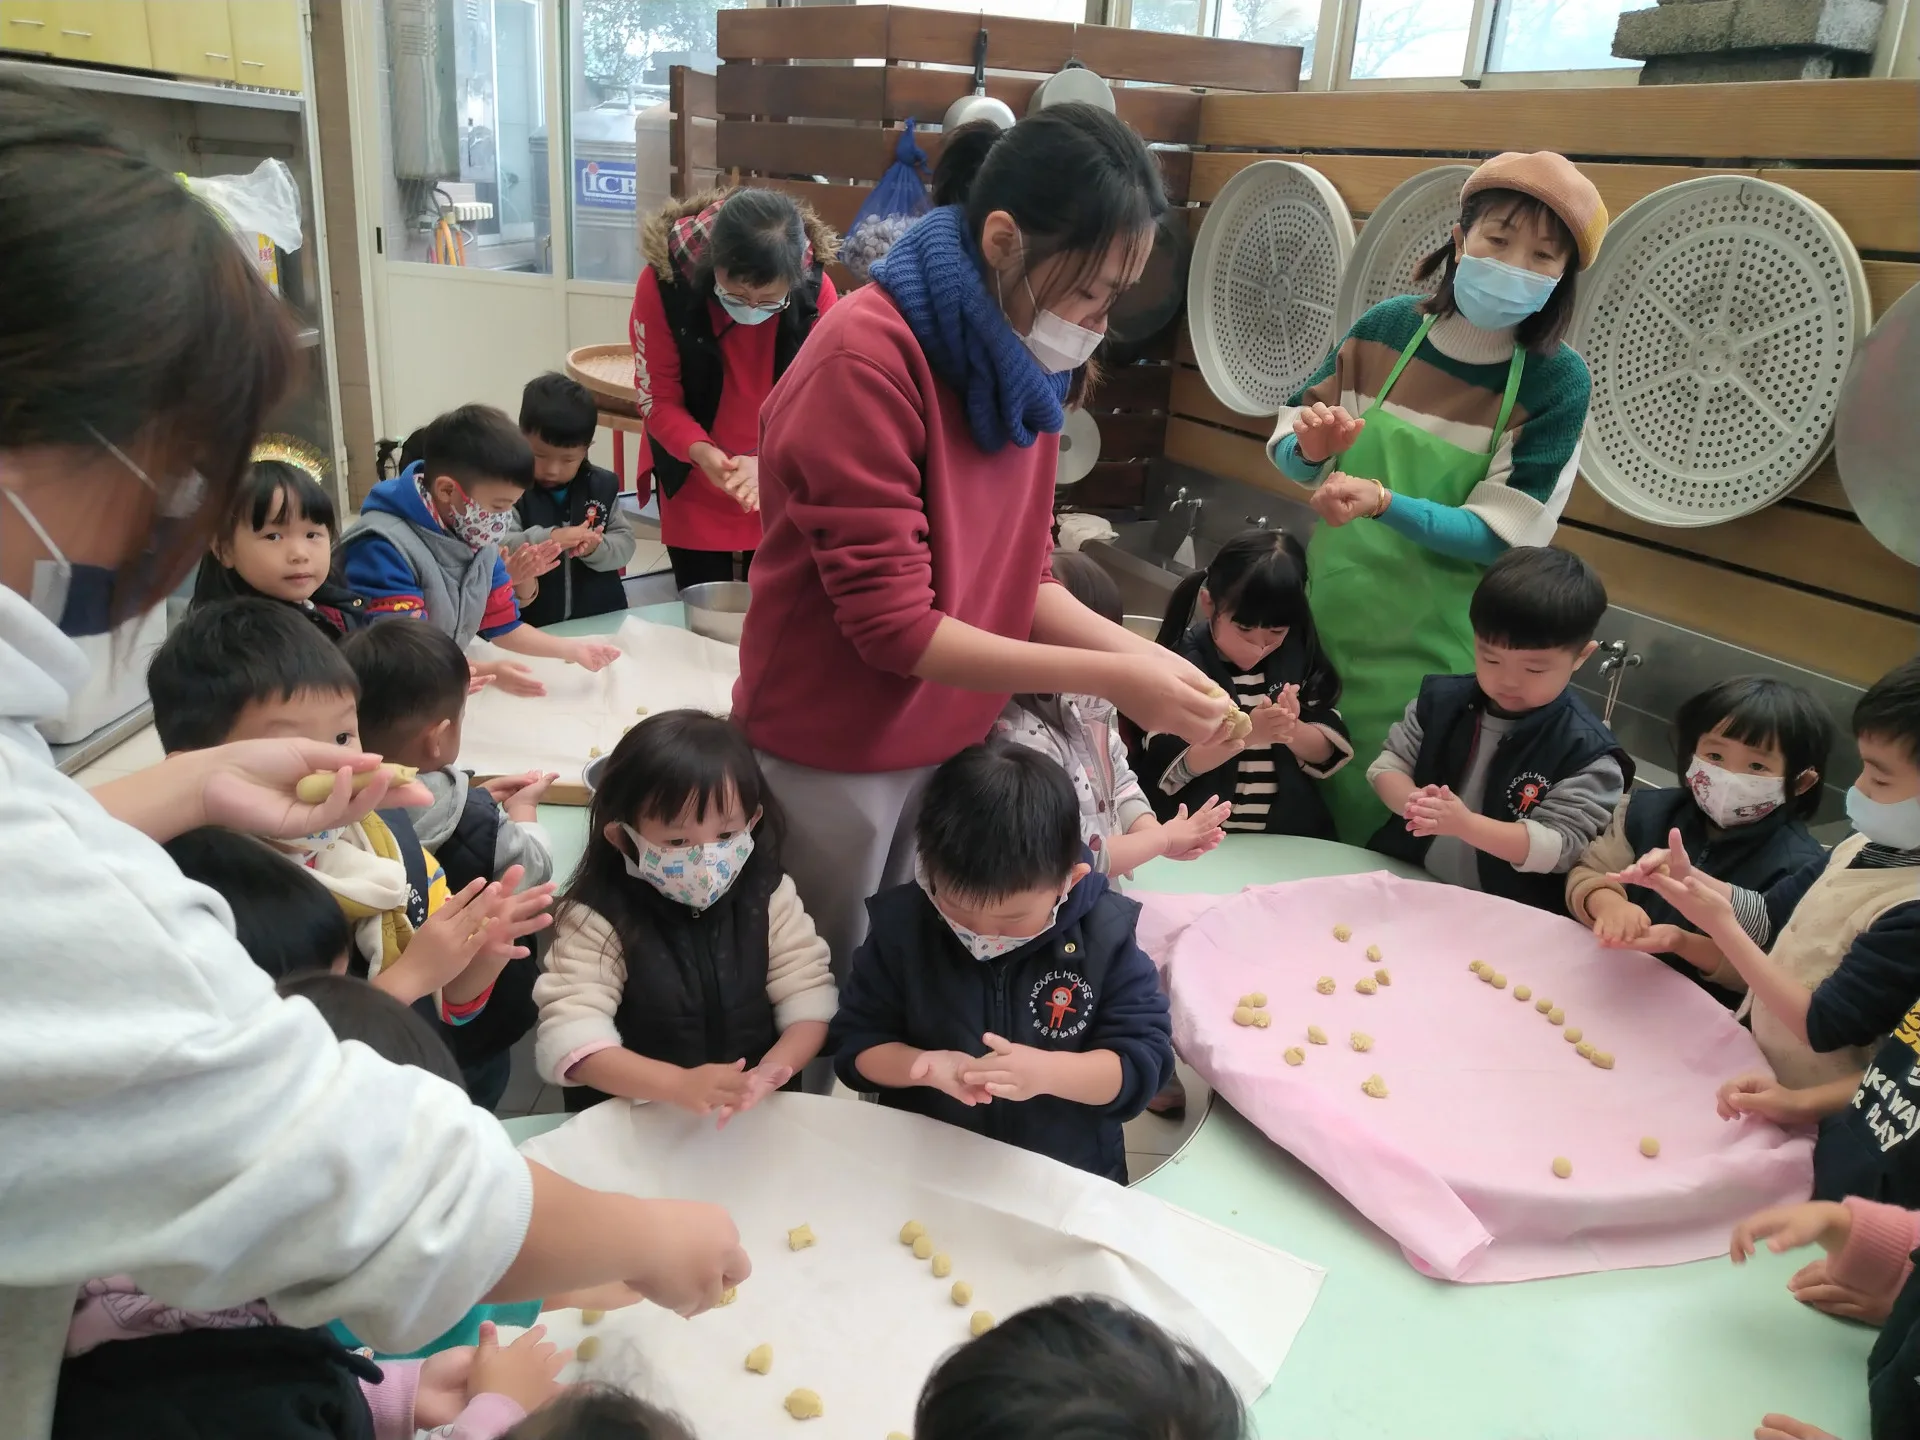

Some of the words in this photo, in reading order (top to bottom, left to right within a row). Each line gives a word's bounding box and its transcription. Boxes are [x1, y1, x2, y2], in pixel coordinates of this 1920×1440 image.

[1031, 970, 1061, 999] NOVEL
[1063, 970, 1093, 1000] HOUSE
[1866, 1103, 1904, 1152] PLAY
